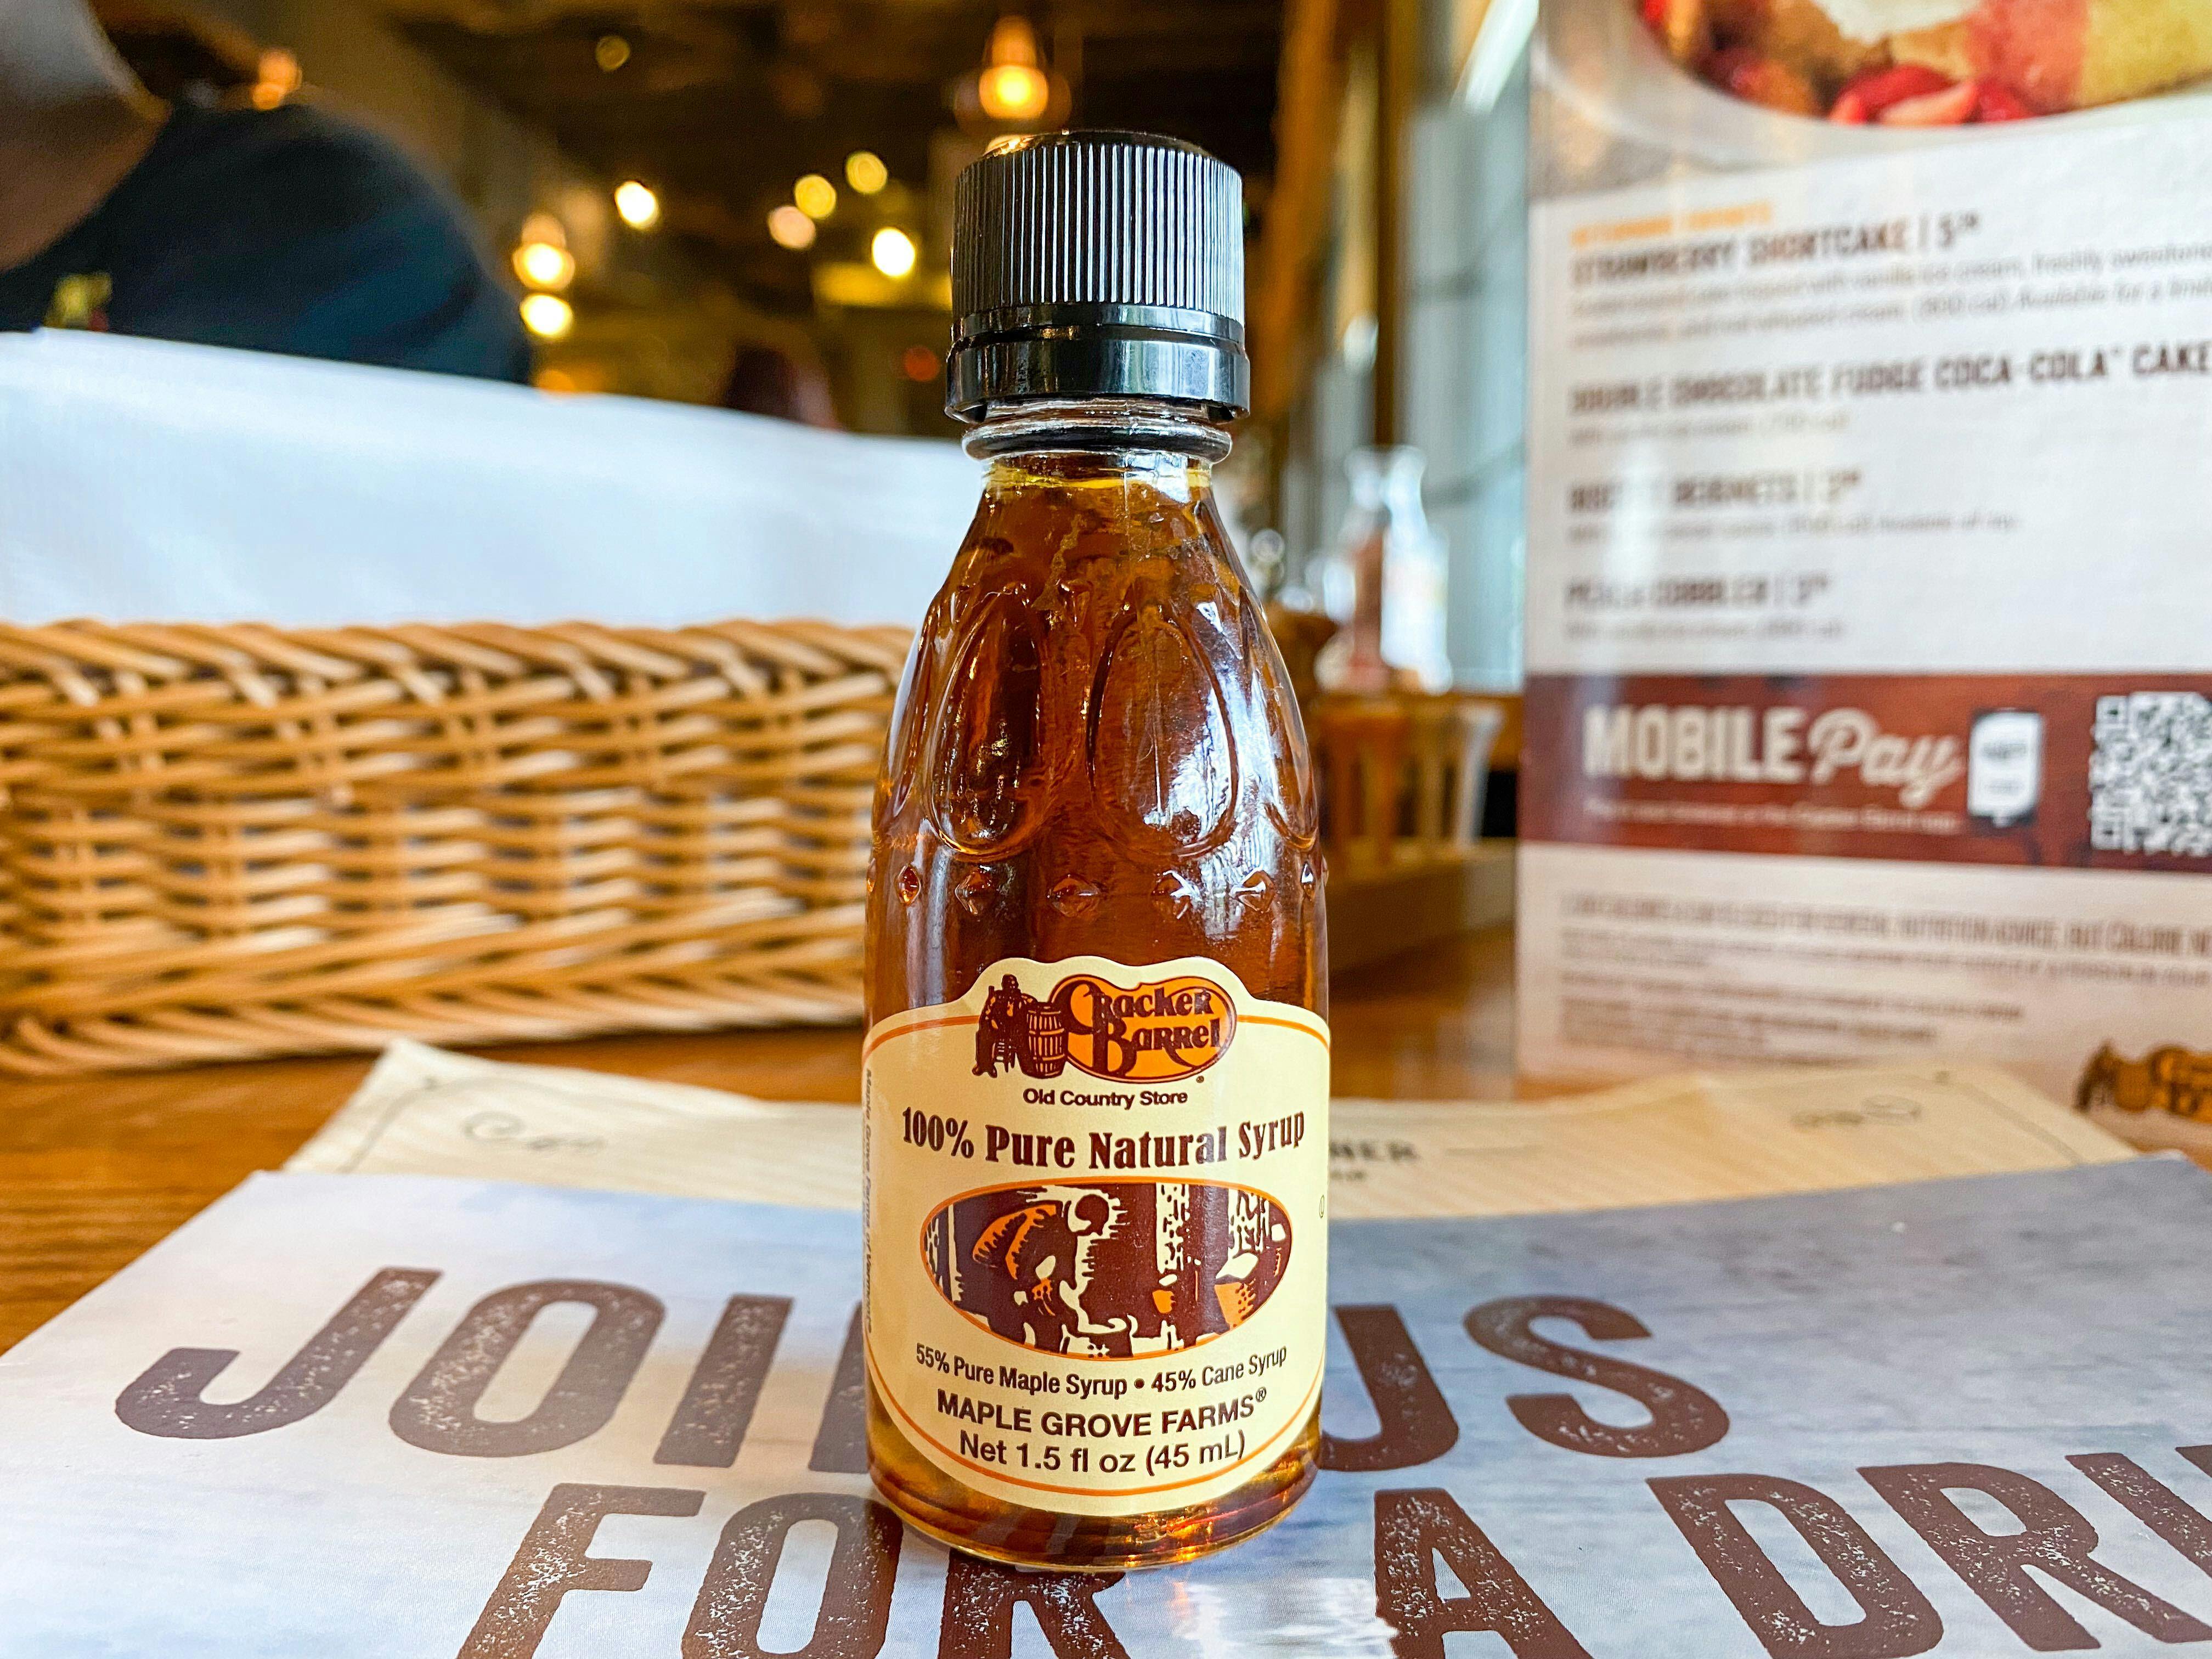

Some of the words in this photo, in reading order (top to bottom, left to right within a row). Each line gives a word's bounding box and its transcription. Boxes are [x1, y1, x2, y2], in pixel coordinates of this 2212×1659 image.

[1583, 703, 1808, 782] MOBILE
[1808, 708, 1962, 809] Pay
[1063, 980, 1214, 1035] Cracker
[1093, 1015, 1220, 1076] Barrel
[1023, 1088, 1055, 1105] Old
[1060, 1090, 1135, 1110] Country
[1139, 1090, 1188, 1106] Store
[902, 1106, 974, 1159] 100%
[985, 1124, 1075, 1169] Pure
[1088, 1126, 1227, 1169] Natural
[1239, 1111, 1305, 1160] Syrup
[916, 1342, 950, 1374] 55%
[954, 1355, 995, 1385] Pure
[999, 1365, 1060, 1396] Maple
[1066, 1373, 1127, 1400] Syrup
[1151, 1368, 1197, 1392] 45%
[1201, 1362, 1244, 1386] Cane
[1249, 1345, 1286, 1376] Syrup
[938, 1388, 1031, 1433] MAPLE
[1041, 1411, 1152, 1438] GROVE
[961, 1429, 1007, 1465] Net
[1016, 1442, 1060, 1470] 1.5
[1070, 1447, 1088, 1472] fl
[1099, 1454, 1136, 1473] oz
[1146, 1442, 1189, 1476] (45
[1199, 1429, 1245, 1464] mL)
[1374, 1488, 1596, 1659] A
[1647, 1444, 2212, 1659] DRI
